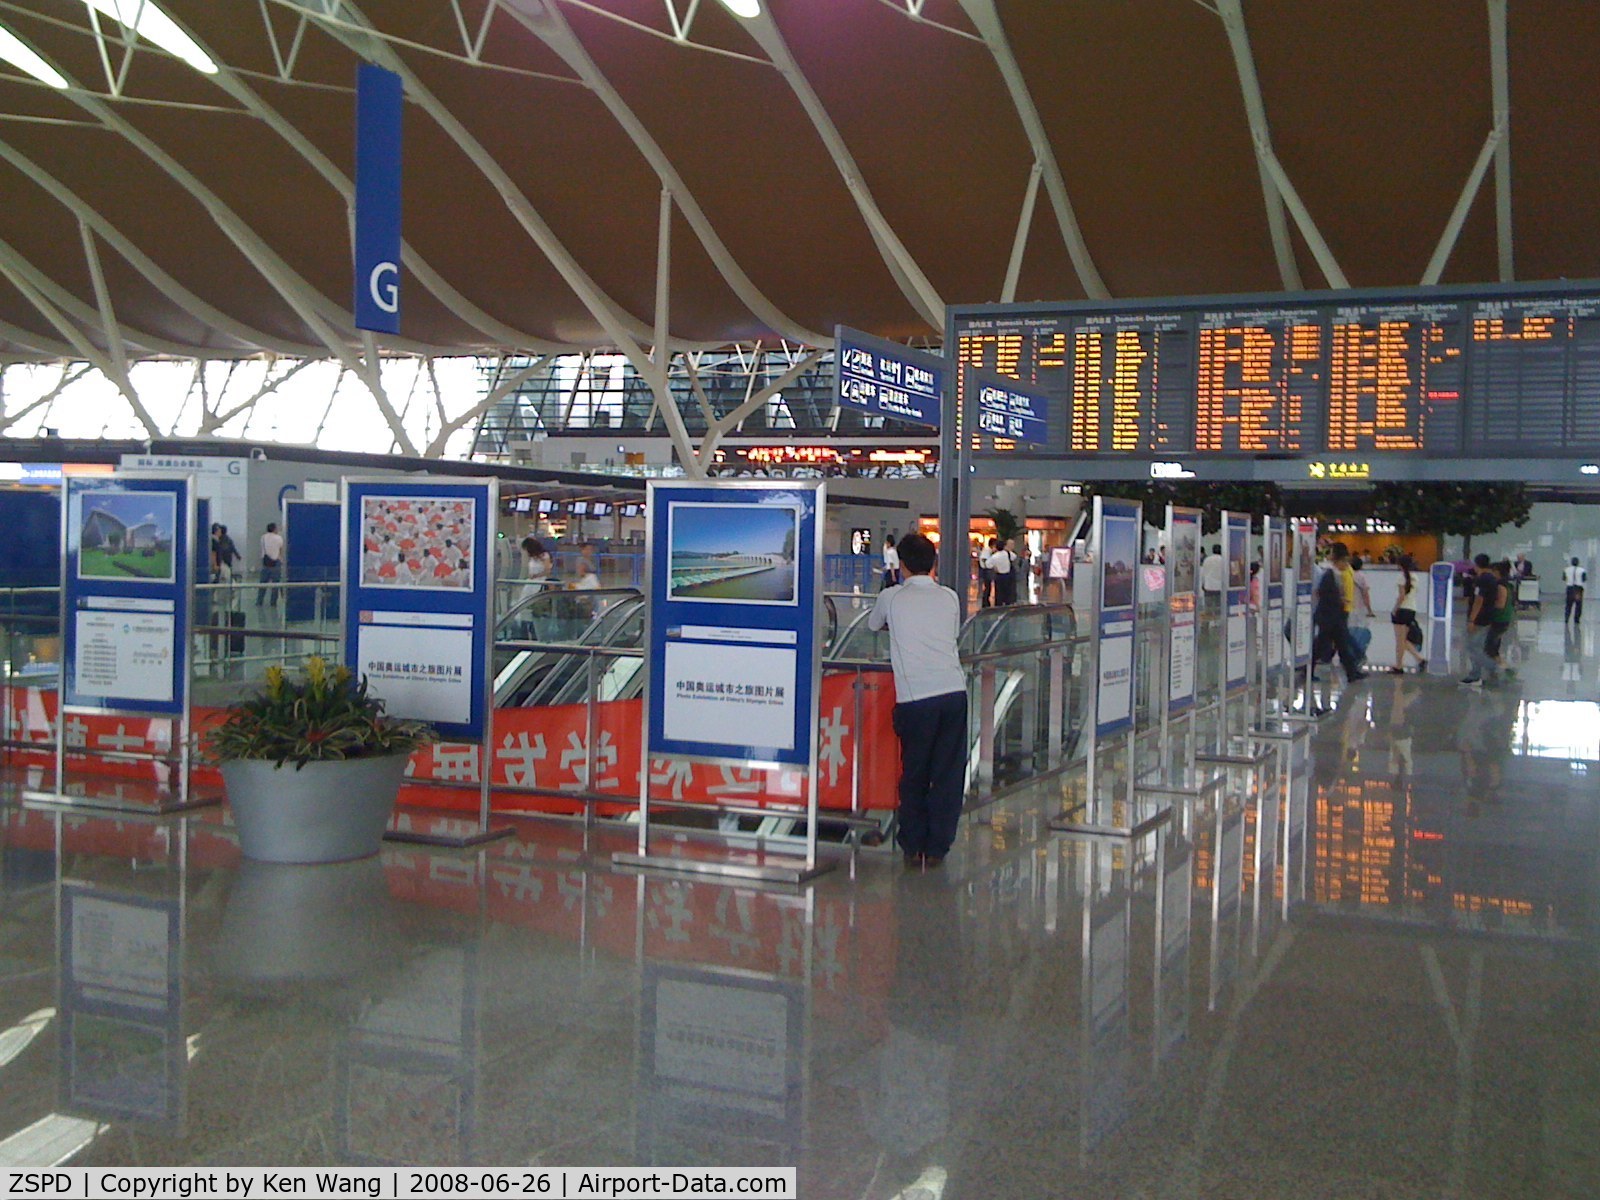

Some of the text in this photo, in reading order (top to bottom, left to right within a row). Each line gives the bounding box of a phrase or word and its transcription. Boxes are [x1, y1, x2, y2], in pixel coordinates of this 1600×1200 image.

[370, 262, 398, 313] G
[996, 318, 1058, 327] Domestic Departures
[1115, 314, 1181, 323] Domestic Departures
[227, 460, 241, 475] G
[368, 660, 462, 676] 中国奥运城市之旅图片展
[676, 680, 785, 698] 中国奥运城市之旅图片展
